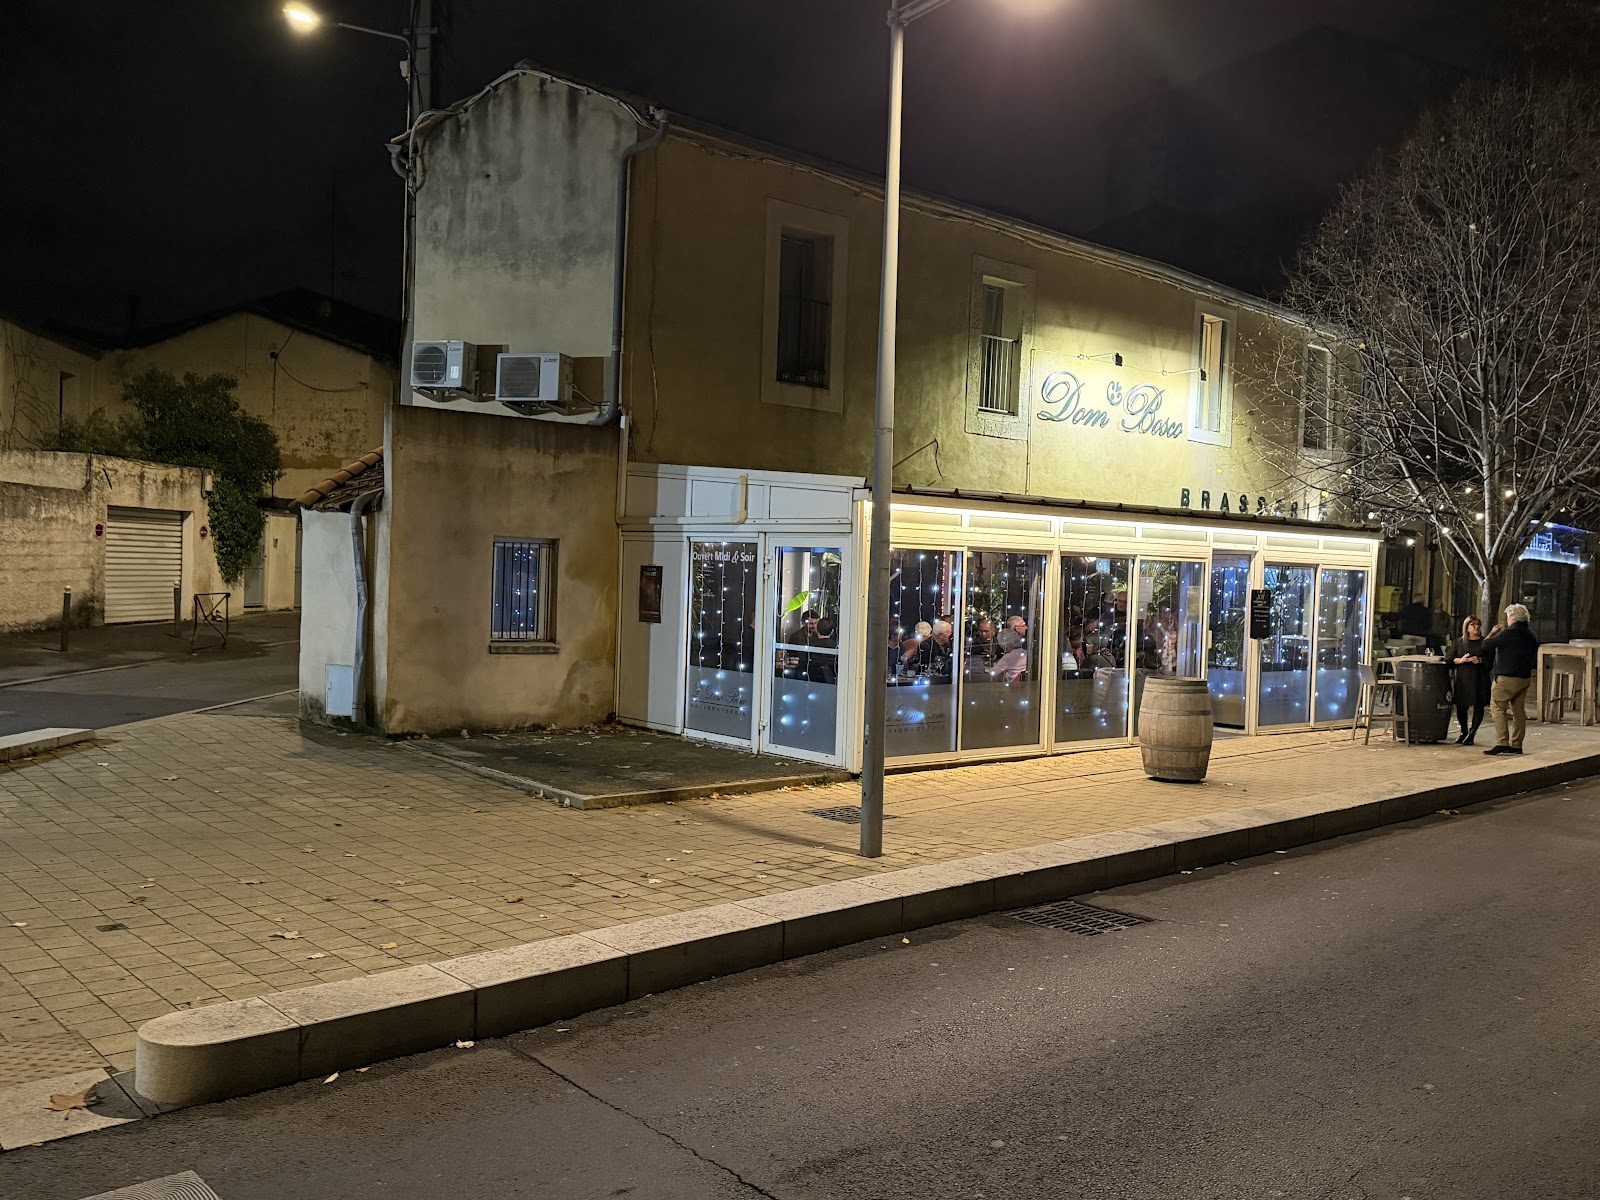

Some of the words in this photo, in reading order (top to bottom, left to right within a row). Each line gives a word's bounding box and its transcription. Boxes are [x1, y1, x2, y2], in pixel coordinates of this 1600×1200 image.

[1037, 371, 1110, 428] Dom
[1120, 383, 1184, 439] Bosco
[714, 550, 731, 562] Midi
[731, 550, 740, 564] &
[740, 551, 756, 563] Soir
